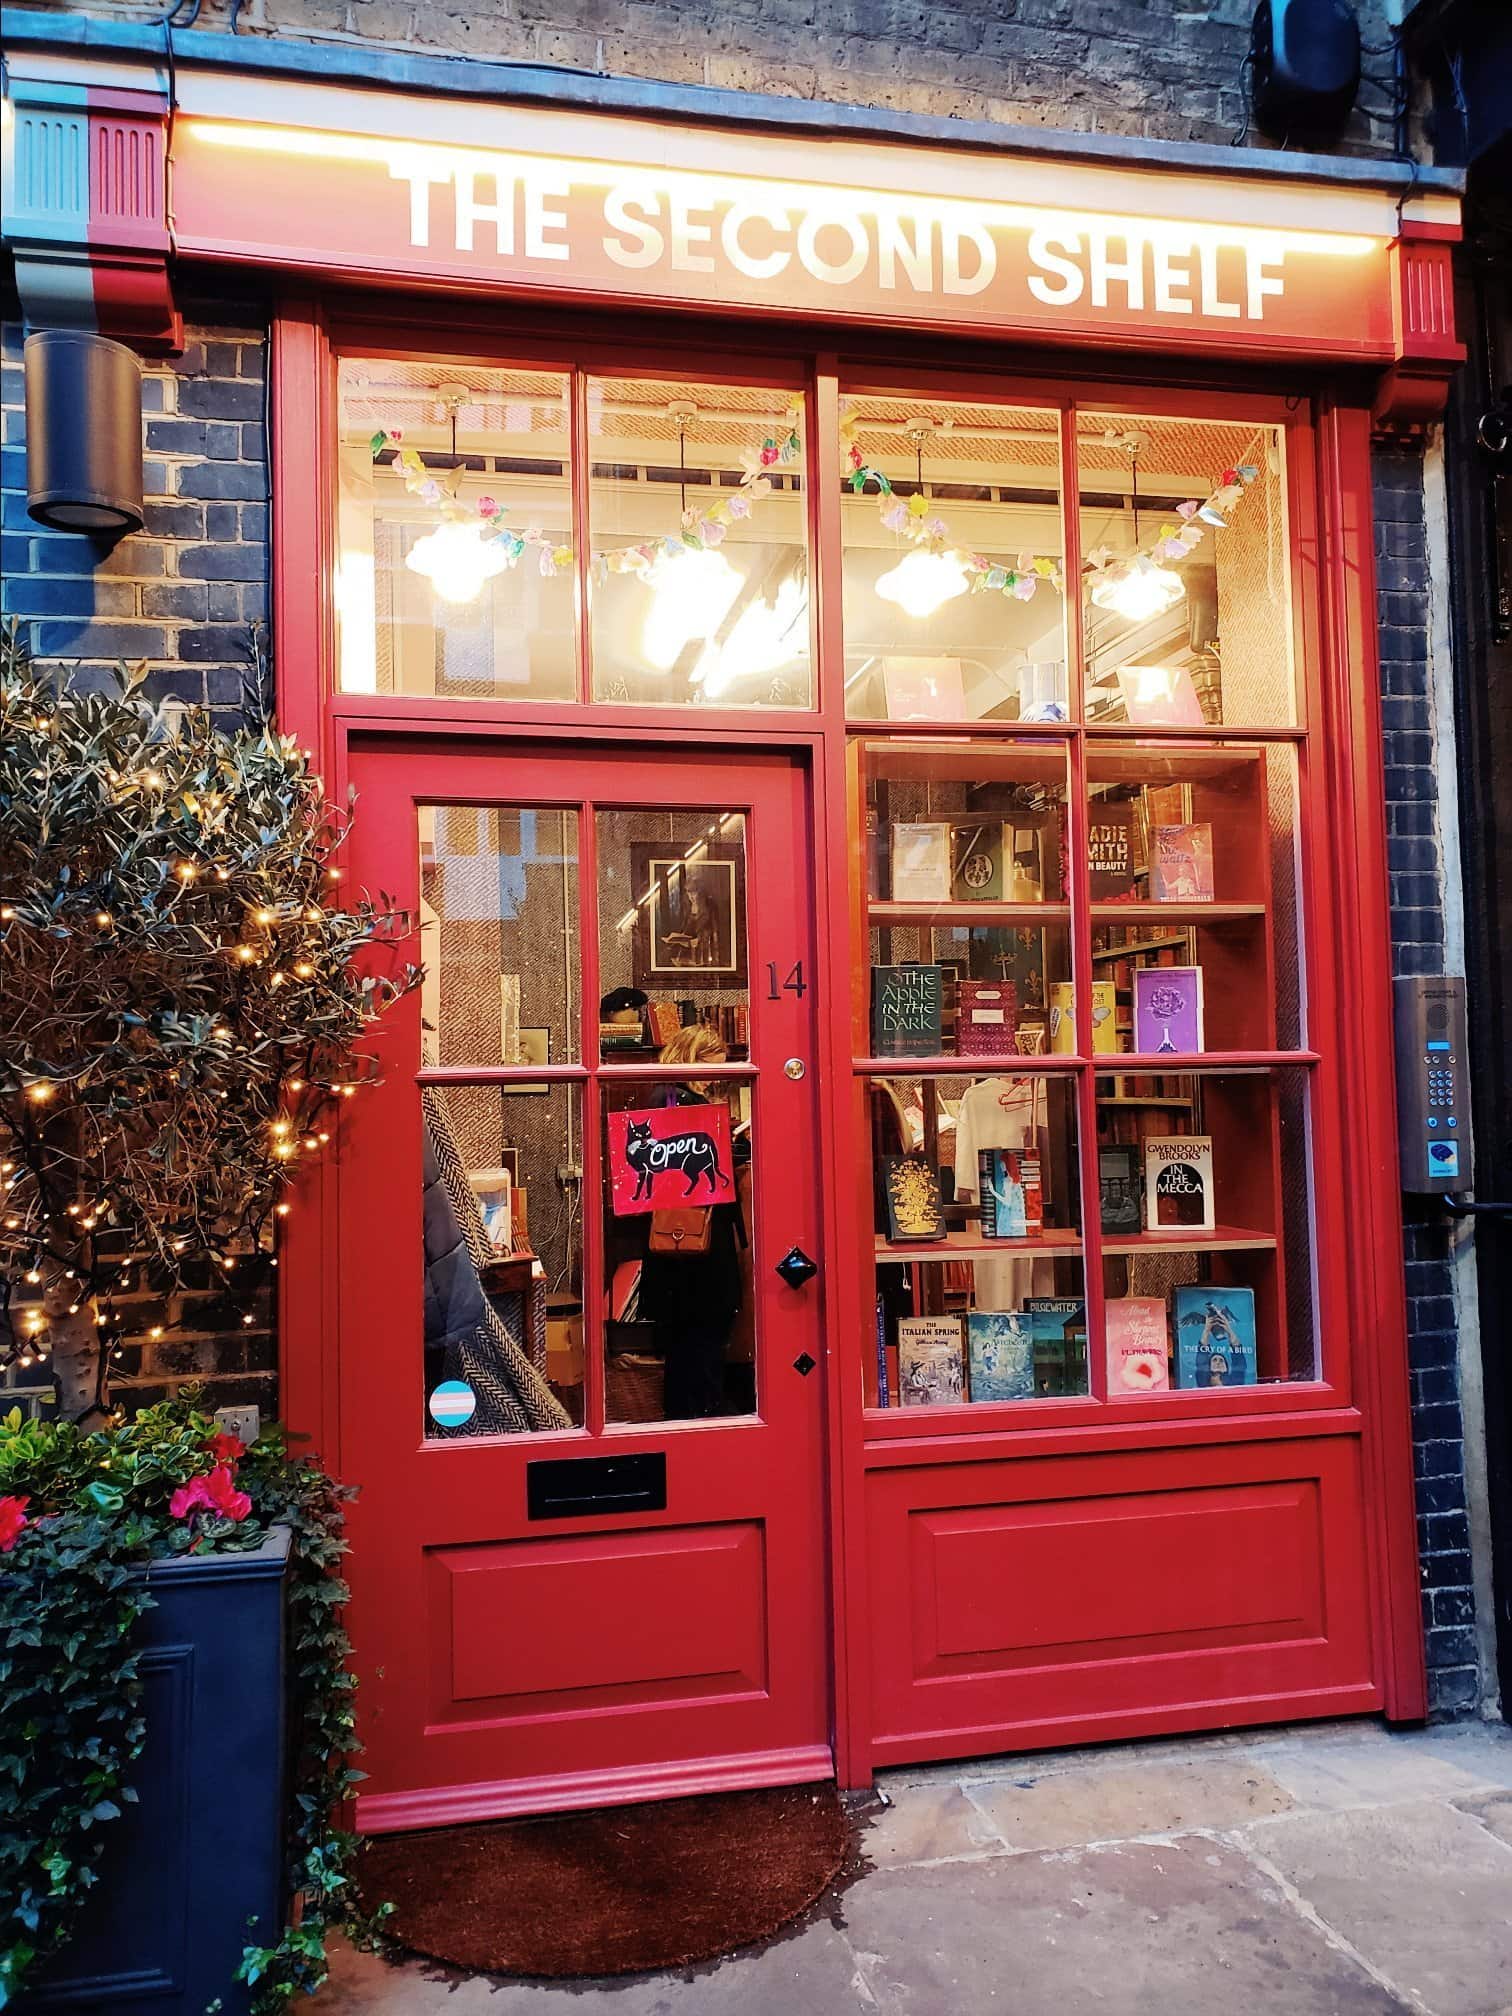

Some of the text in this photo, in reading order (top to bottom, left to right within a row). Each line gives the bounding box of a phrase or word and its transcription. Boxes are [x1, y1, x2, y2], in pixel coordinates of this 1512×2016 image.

[388, 166, 1285, 320] THE SECOND SHELF
[1089, 825, 1128, 842] ADIE
[1088, 843, 1128, 860] MITH
[1096, 861, 1127, 870] BEAUTY
[766, 960, 807, 1000] 14
[883, 1001, 936, 1015] IN THE
[883, 1014, 936, 1030] DARK
[650, 1137, 708, 1168] Open
[1147, 1144, 1210, 1152] GWENDOLYN
[1160, 1152, 1201, 1160] BROOKS
[1170, 1165, 1183, 1175] IN
[1163, 1174, 1188, 1184] THE
[1157, 1183, 1203, 1193] MECCA
[902, 1328, 960, 1336] ITALIAN SPRING
[1184, 1345, 1199, 1353] THE
[1200, 1345, 1215, 1353] CRY
[1216, 1345, 1226, 1353] OF
[1234, 1346, 1253, 1354] BIRD
